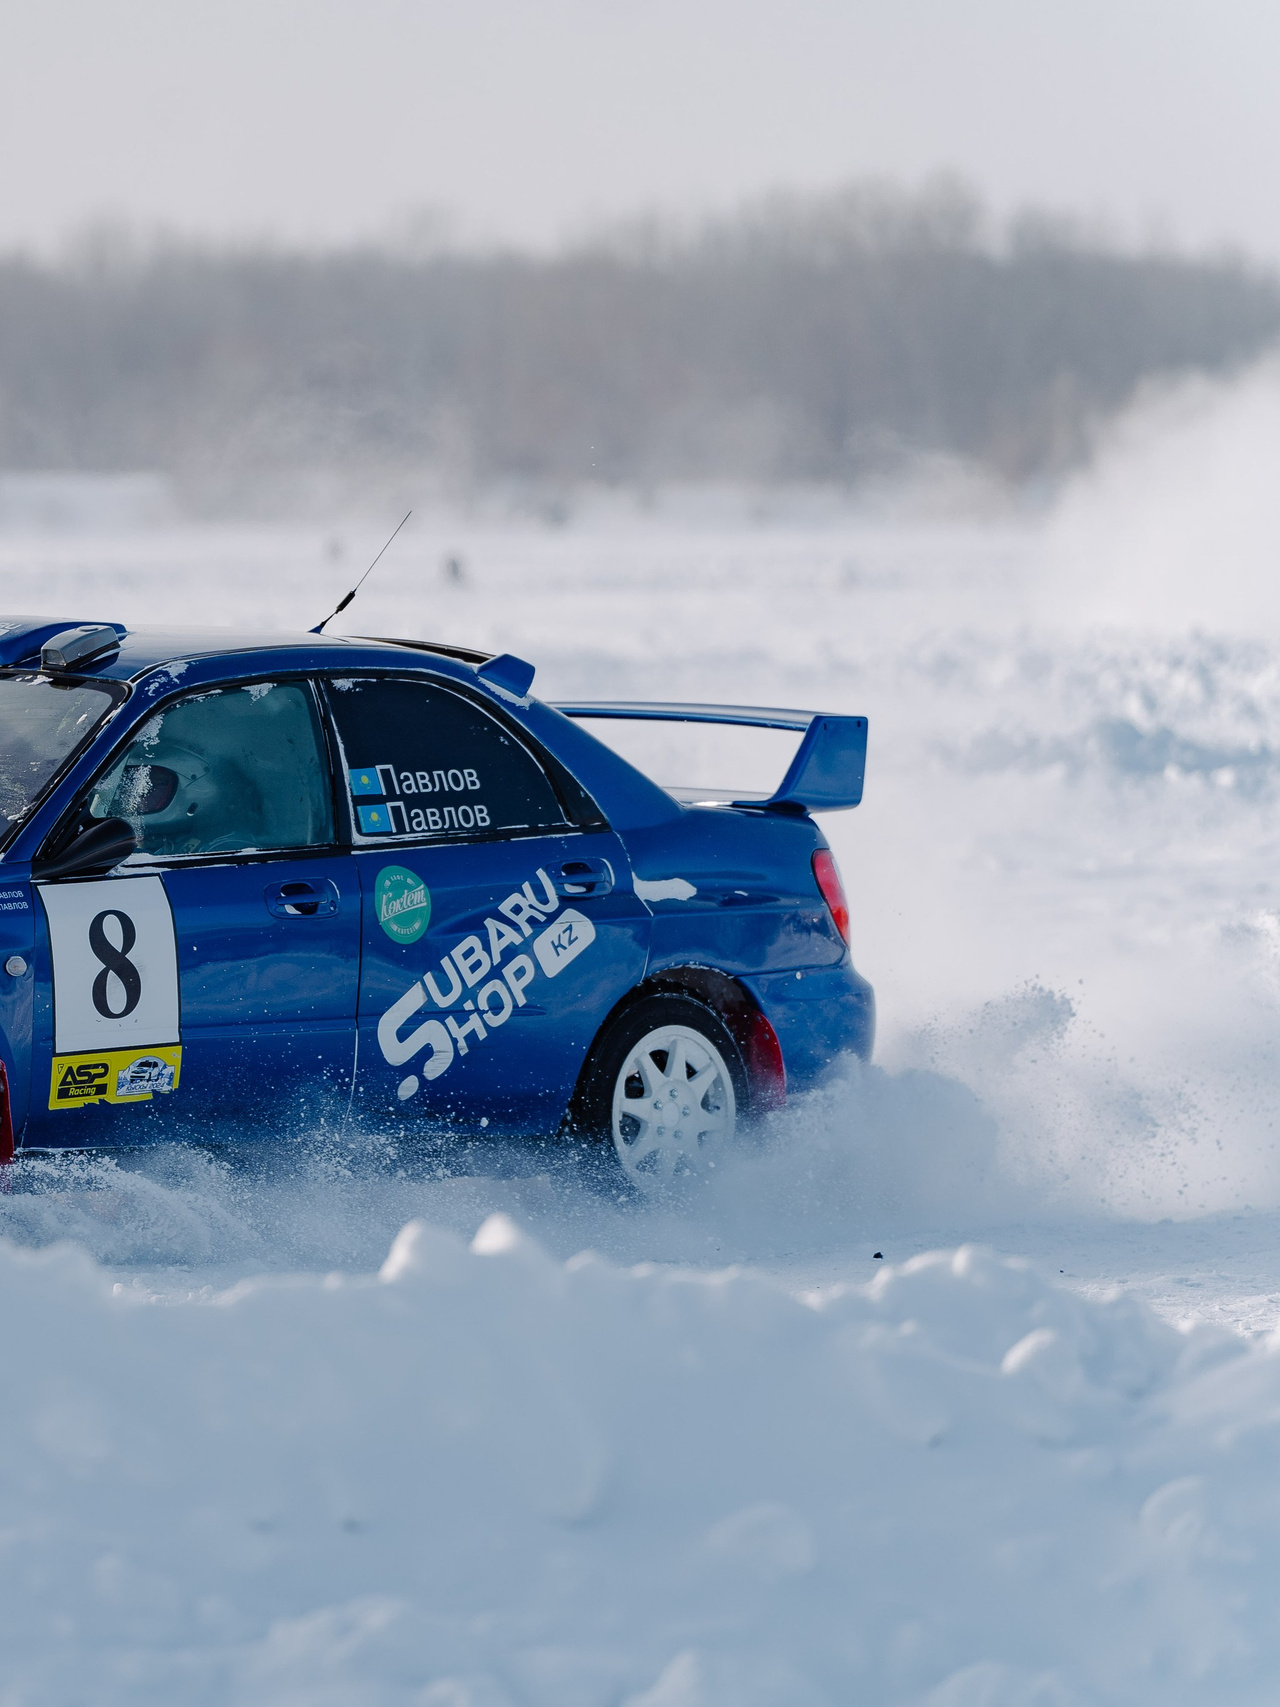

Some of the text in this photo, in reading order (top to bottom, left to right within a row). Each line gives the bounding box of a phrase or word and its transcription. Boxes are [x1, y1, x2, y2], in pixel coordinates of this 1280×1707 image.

[375, 764, 481, 796] Павлов
[386, 801, 491, 833] Павлов
[551, 923, 578, 957] KZ
[89, 909, 142, 1019] 8
[377, 867, 559, 1081] SUBARU
[59, 1063, 109, 1087] ASP
[69, 1086, 96, 1096] Racing
